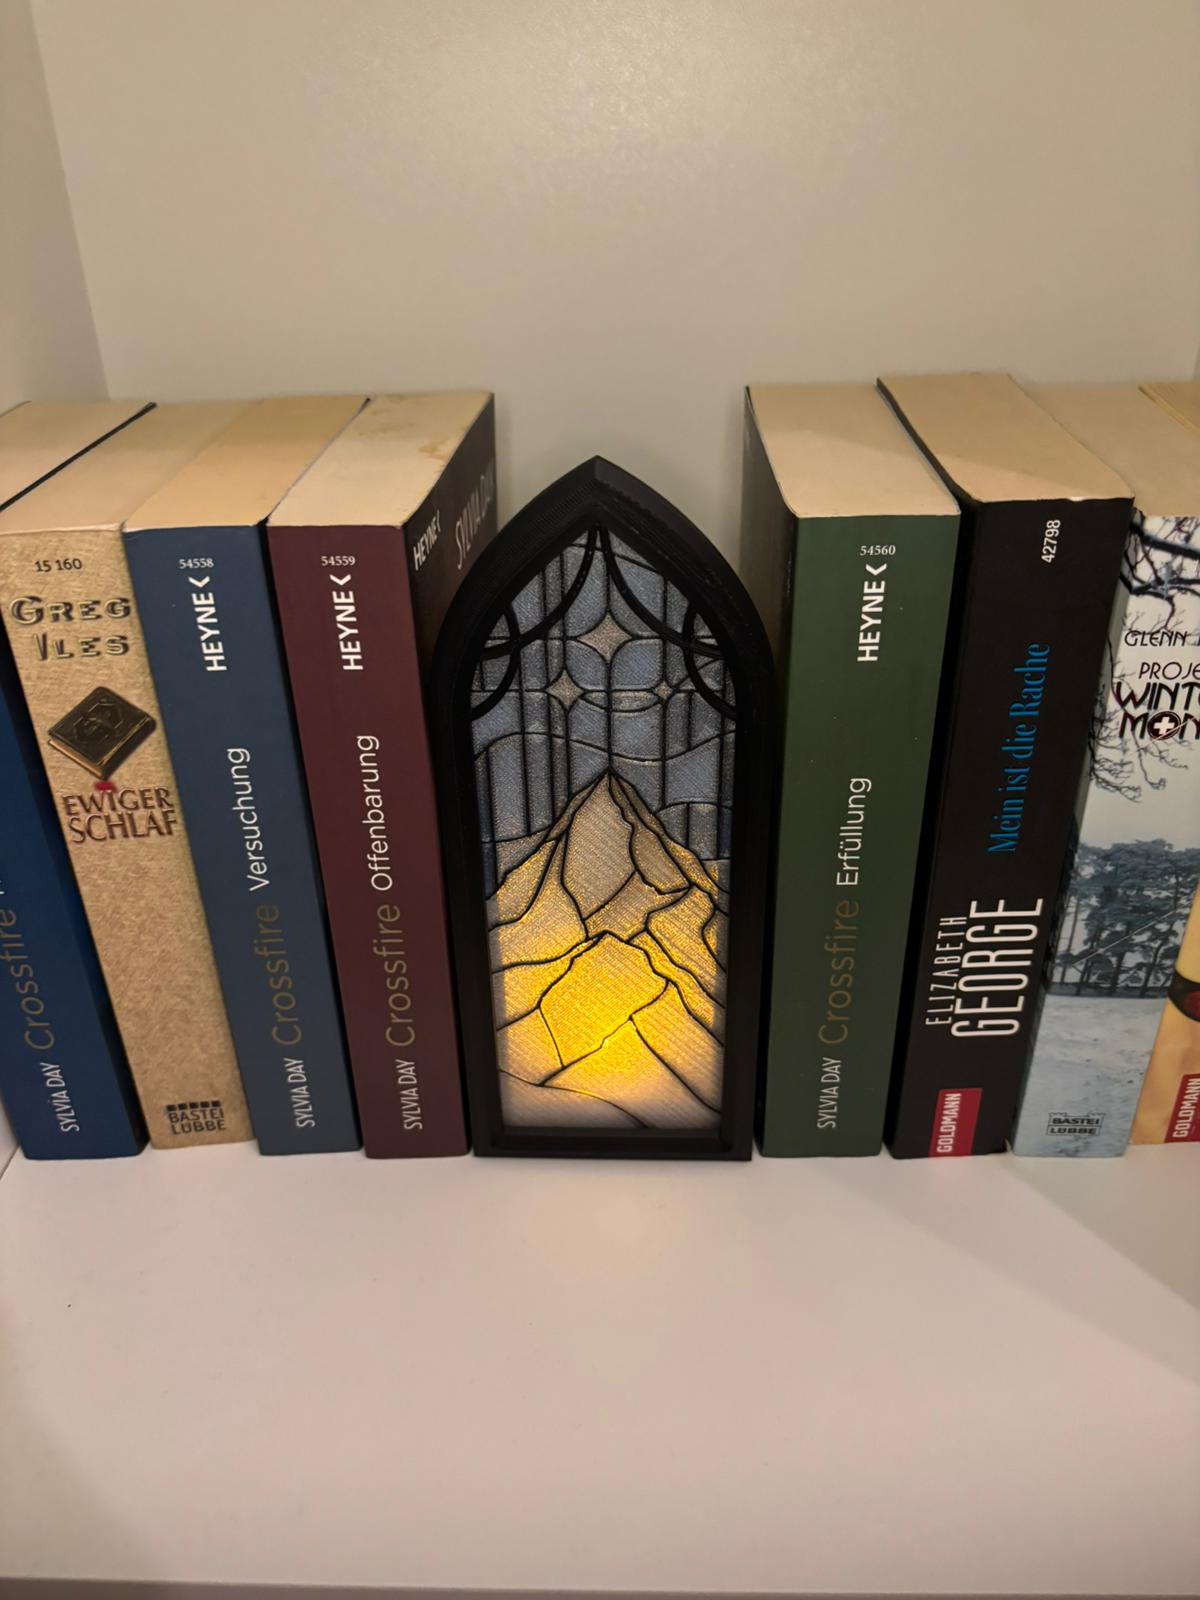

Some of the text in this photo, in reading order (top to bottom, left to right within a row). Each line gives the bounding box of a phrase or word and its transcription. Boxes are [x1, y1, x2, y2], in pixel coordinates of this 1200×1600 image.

[35, 558, 83, 573] 15 160
[179, 558, 214, 569] 54558
[320, 555, 356, 566] 54559
[413, 516, 438, 571] HEYNE
[859, 545, 896, 556] 54560
[1041, 519, 1061, 563] 42798
[9, 595, 132, 626] GREG
[194, 591, 227, 672] HEYNE
[332, 590, 364, 671] HEYNE
[857, 580, 886, 662] HEYNE
[1124, 630, 1188, 647] GLENN
[34, 633, 131, 662] ILES
[1115, 681, 1200, 711] WINT
[987, 643, 1050, 853] Mein ist die Rache
[62, 787, 175, 817] EWIGER
[68, 810, 179, 844] SCHLAF
[227, 748, 301, 1047] Crossfire Versuchung
[356, 735, 416, 1047] Crossfire Offenbarung
[818, 777, 872, 1045] Crossfire Erfüllung
[926, 915, 968, 1026] ELIZABETH
[950, 898, 1044, 1037] GEORGE
[40, 1062, 80, 1132] SYLVIA DAY
[168, 1107, 225, 1124] BASTEI
[283, 1057, 316, 1128] SYLVIA DAY
[397, 1059, 424, 1130] SYLVIA DAY
[817, 1056, 843, 1129] SYLVIA DAY
[1051, 1117, 1100, 1125] BASTEI
[936, 1092, 962, 1154] GOLDMANN
